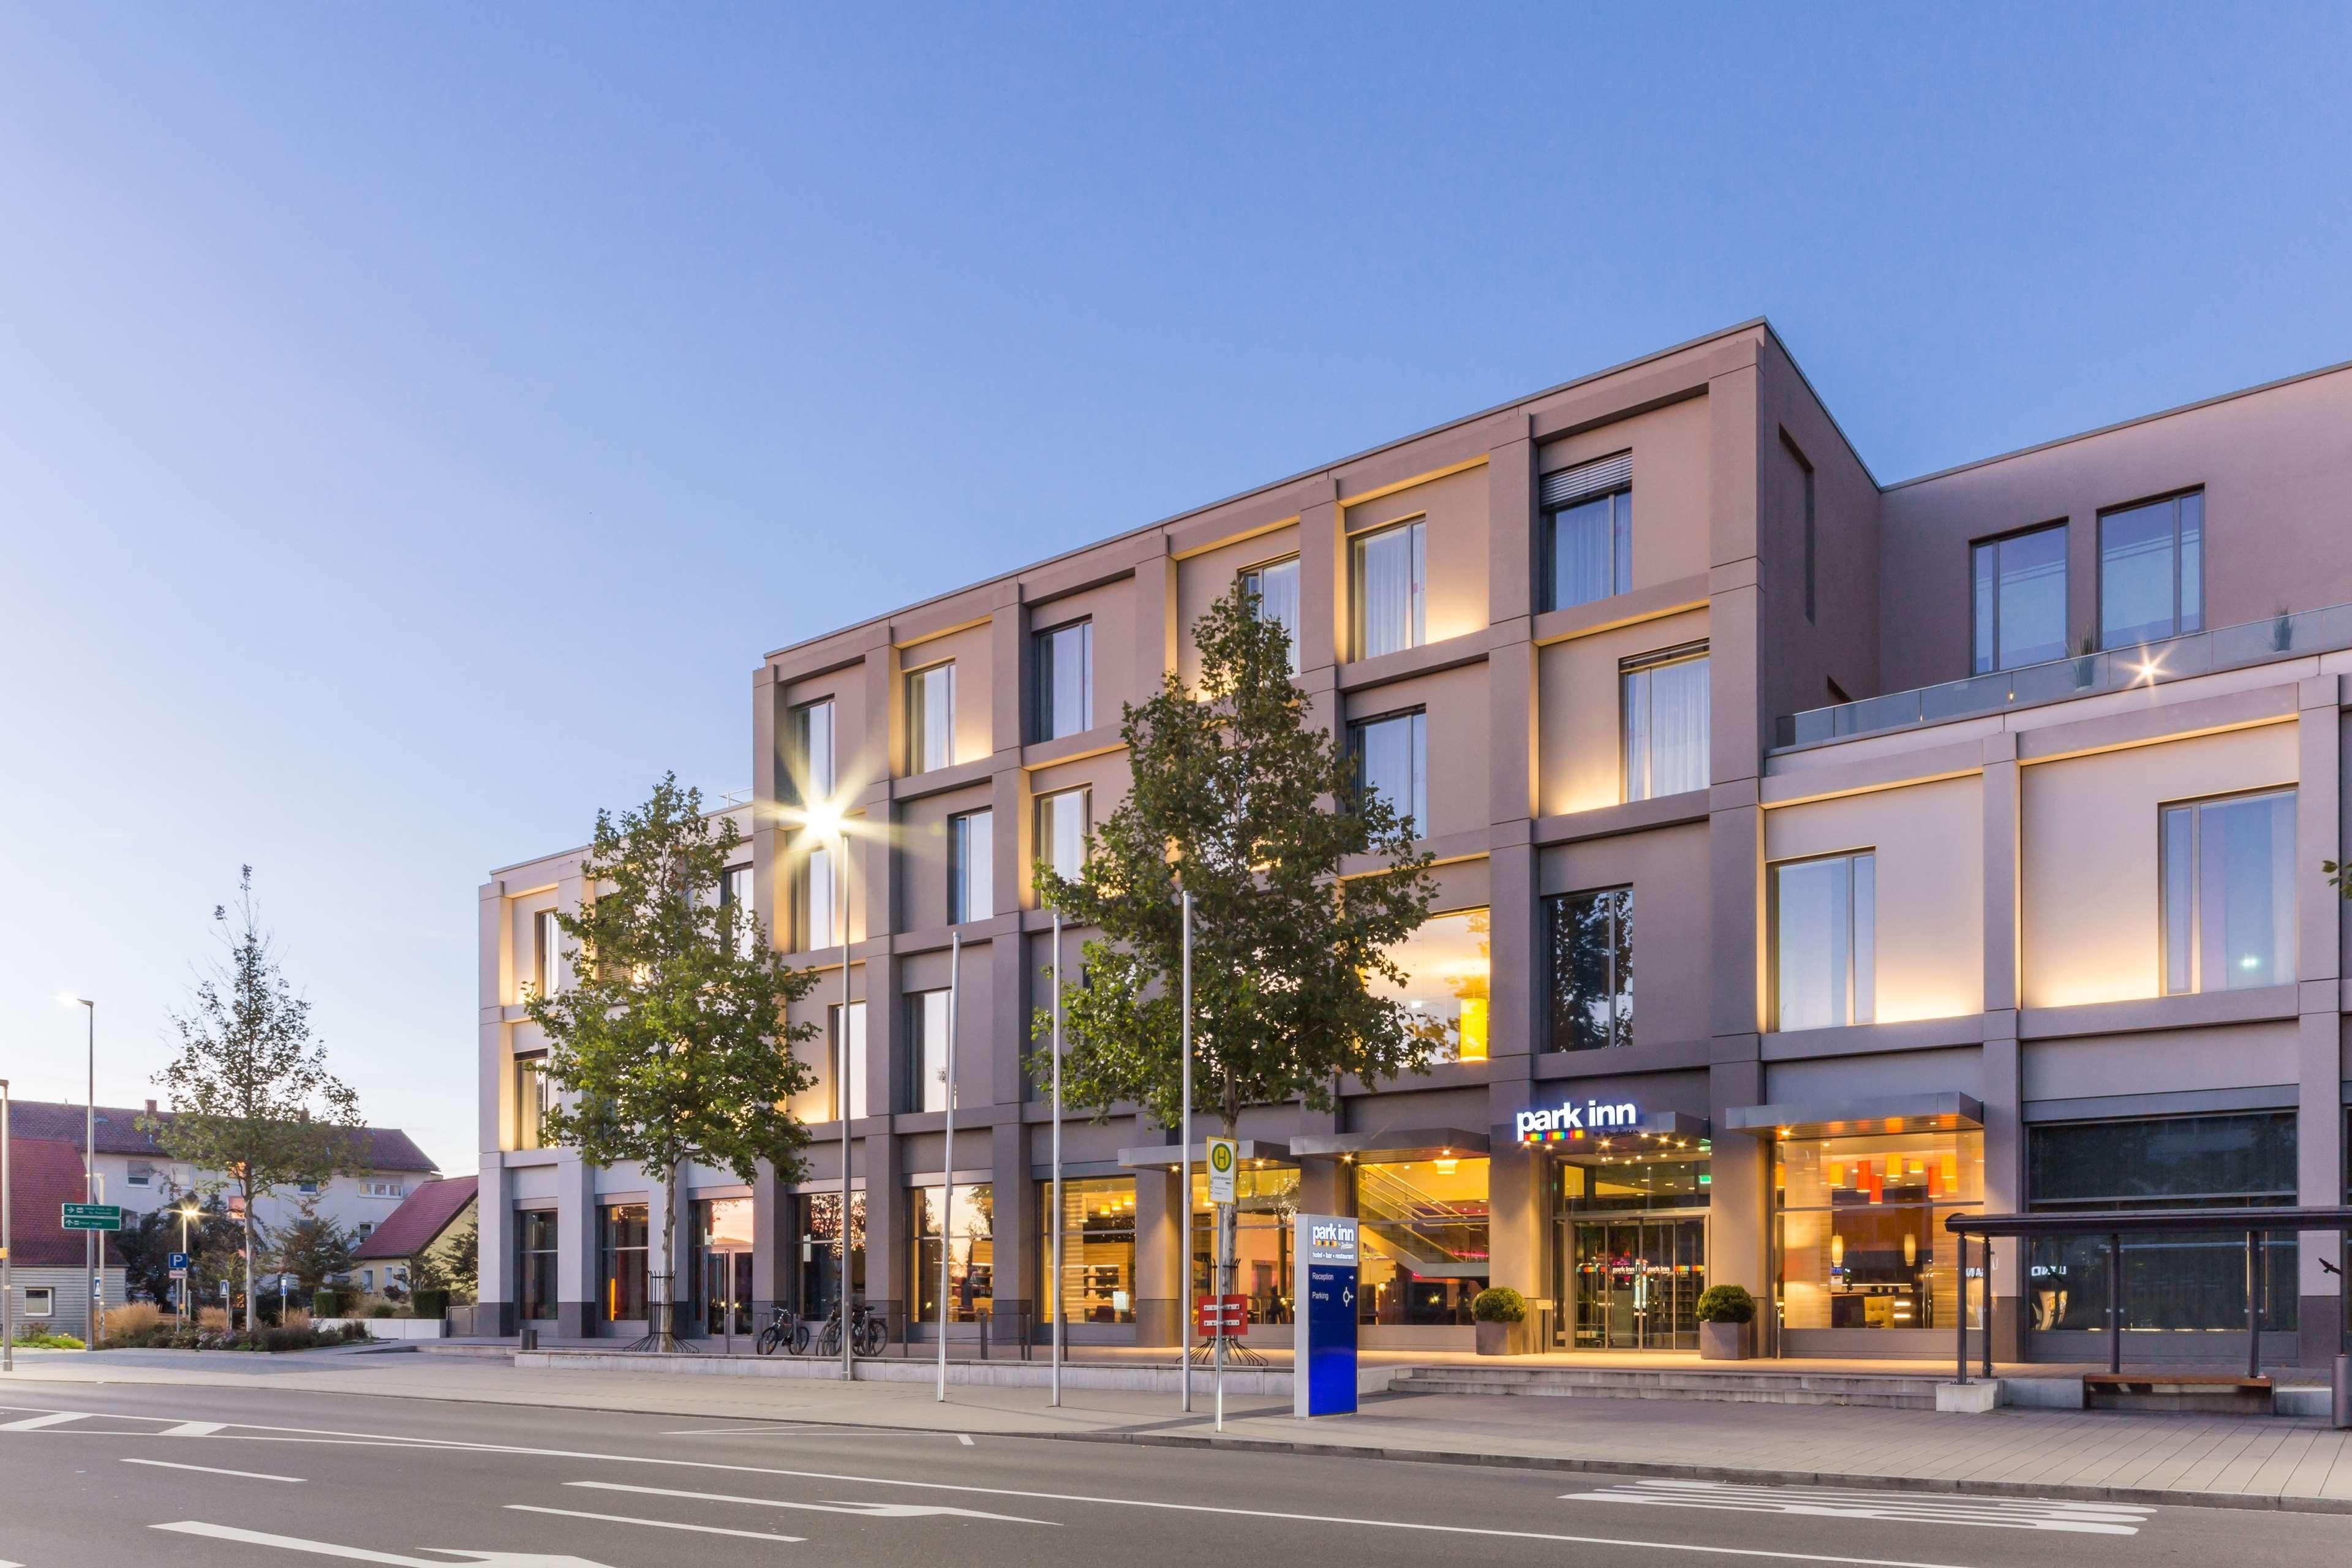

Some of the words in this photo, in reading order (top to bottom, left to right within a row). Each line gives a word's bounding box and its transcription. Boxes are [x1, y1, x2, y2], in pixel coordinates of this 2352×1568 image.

[1517, 1102, 1583, 1142] park
[1588, 1100, 1636, 1126] inn
[1218, 1149, 1226, 1166] H
[1313, 1223, 1336, 1245] park
[1338, 1224, 1354, 1242] inn
[173, 1255, 183, 1266] P
[1312, 1272, 1334, 1281] Reception
[1312, 1291, 1329, 1301] Parking
